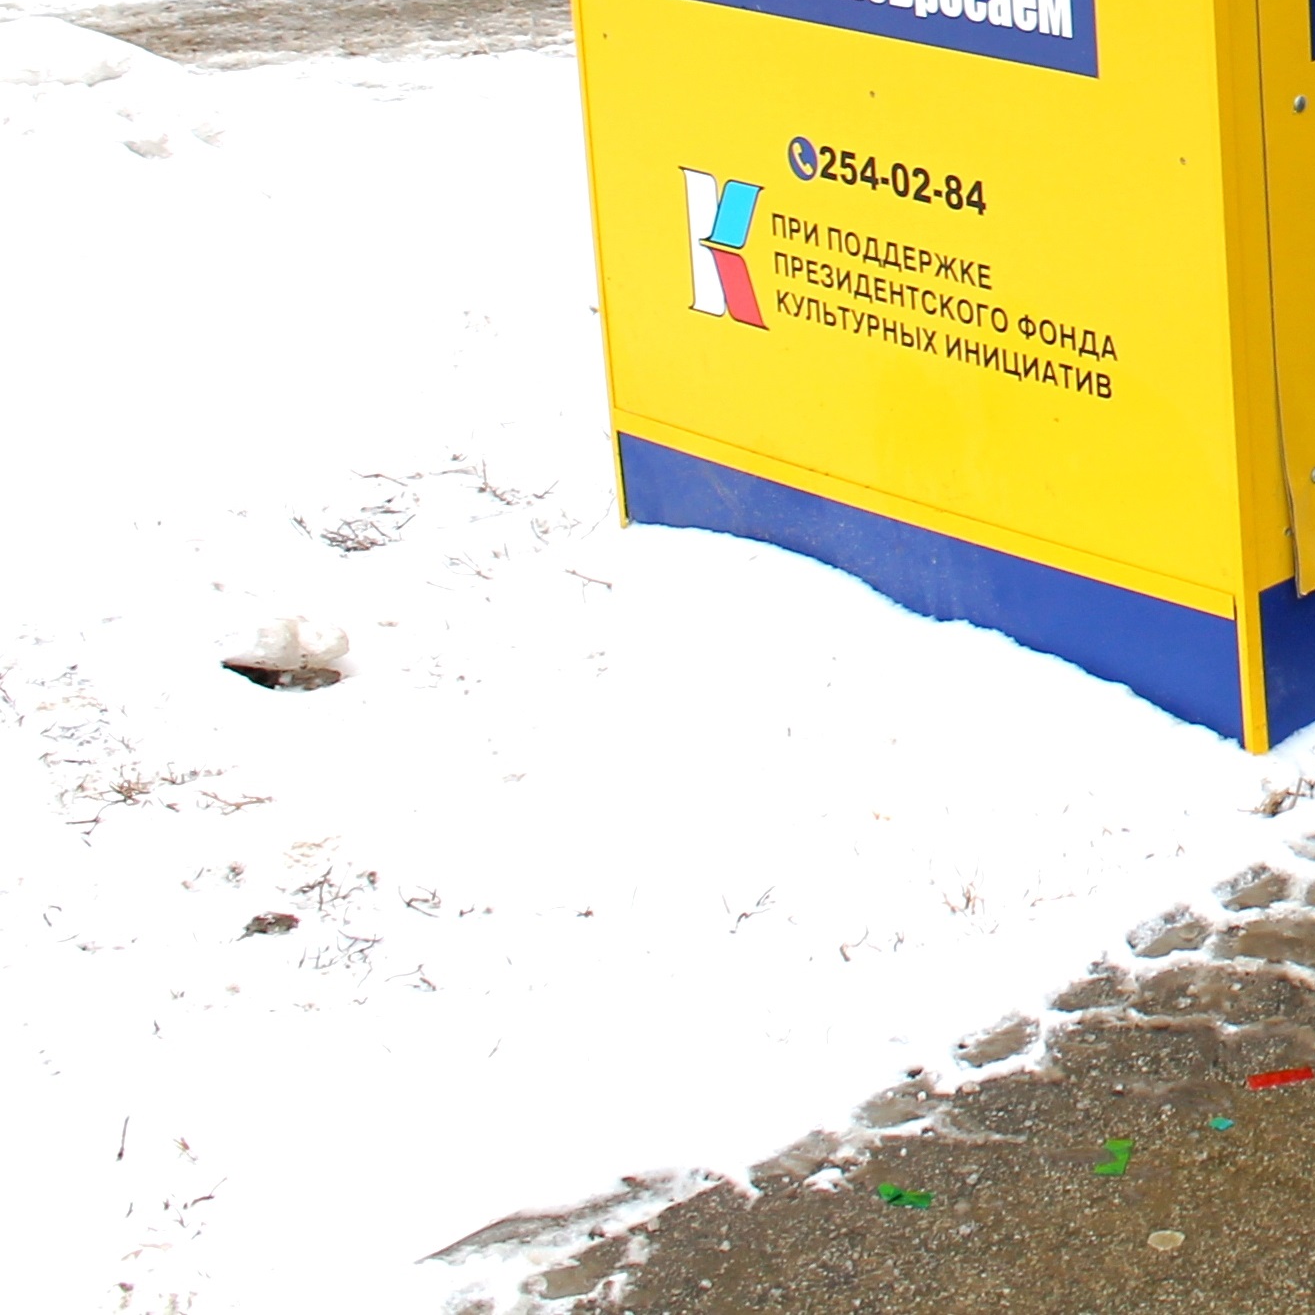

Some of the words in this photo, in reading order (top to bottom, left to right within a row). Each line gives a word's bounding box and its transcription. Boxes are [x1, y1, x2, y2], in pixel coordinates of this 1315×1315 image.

[818, 145, 988, 216] 254-02-84
[771, 212, 820, 247] ПРИ
[826, 226, 993, 291] ПОДДЕРЖКЕ
[773, 251, 1010, 334] ПРЕЗИДЕНТСКОГО
[1016, 313, 1119, 363] ФОНДА
[776, 289, 938, 356] КУЛЬТУРНЫХ
[945, 333, 1113, 400] ИНИЦИАТИВ
